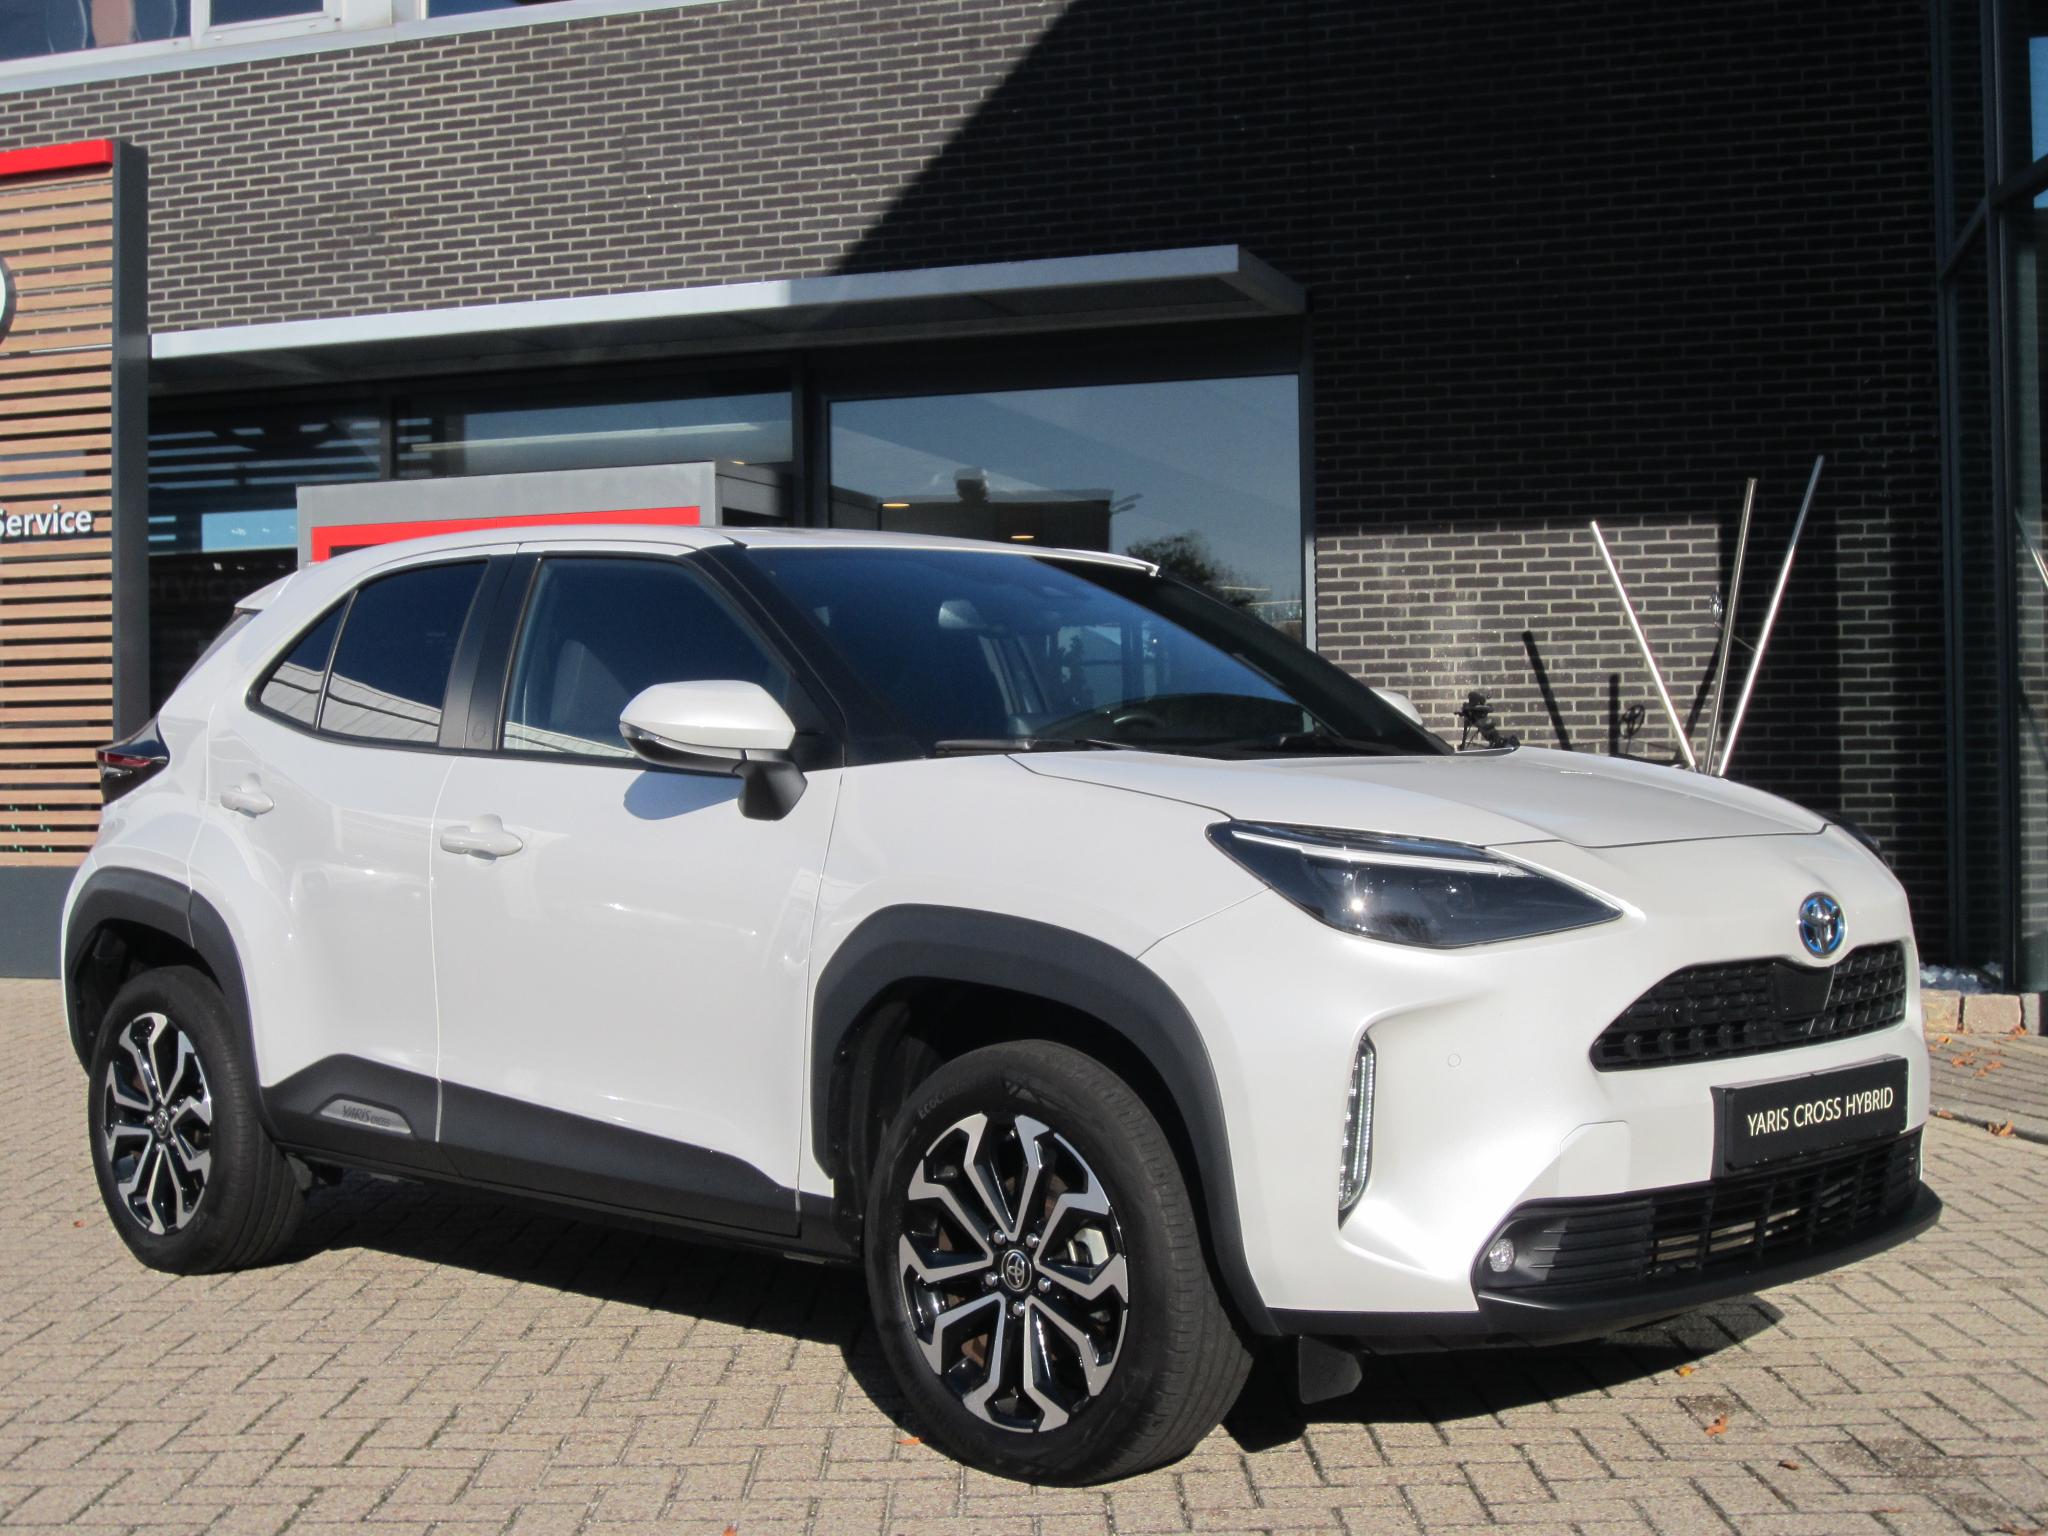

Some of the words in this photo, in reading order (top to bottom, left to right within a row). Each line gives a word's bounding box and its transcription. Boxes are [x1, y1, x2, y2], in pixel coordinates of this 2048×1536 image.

[1747, 1108, 1789, 1136] YARIS
[1793, 1097, 1841, 1127] CROSS
[1846, 1088, 1894, 1116] HYBRID
